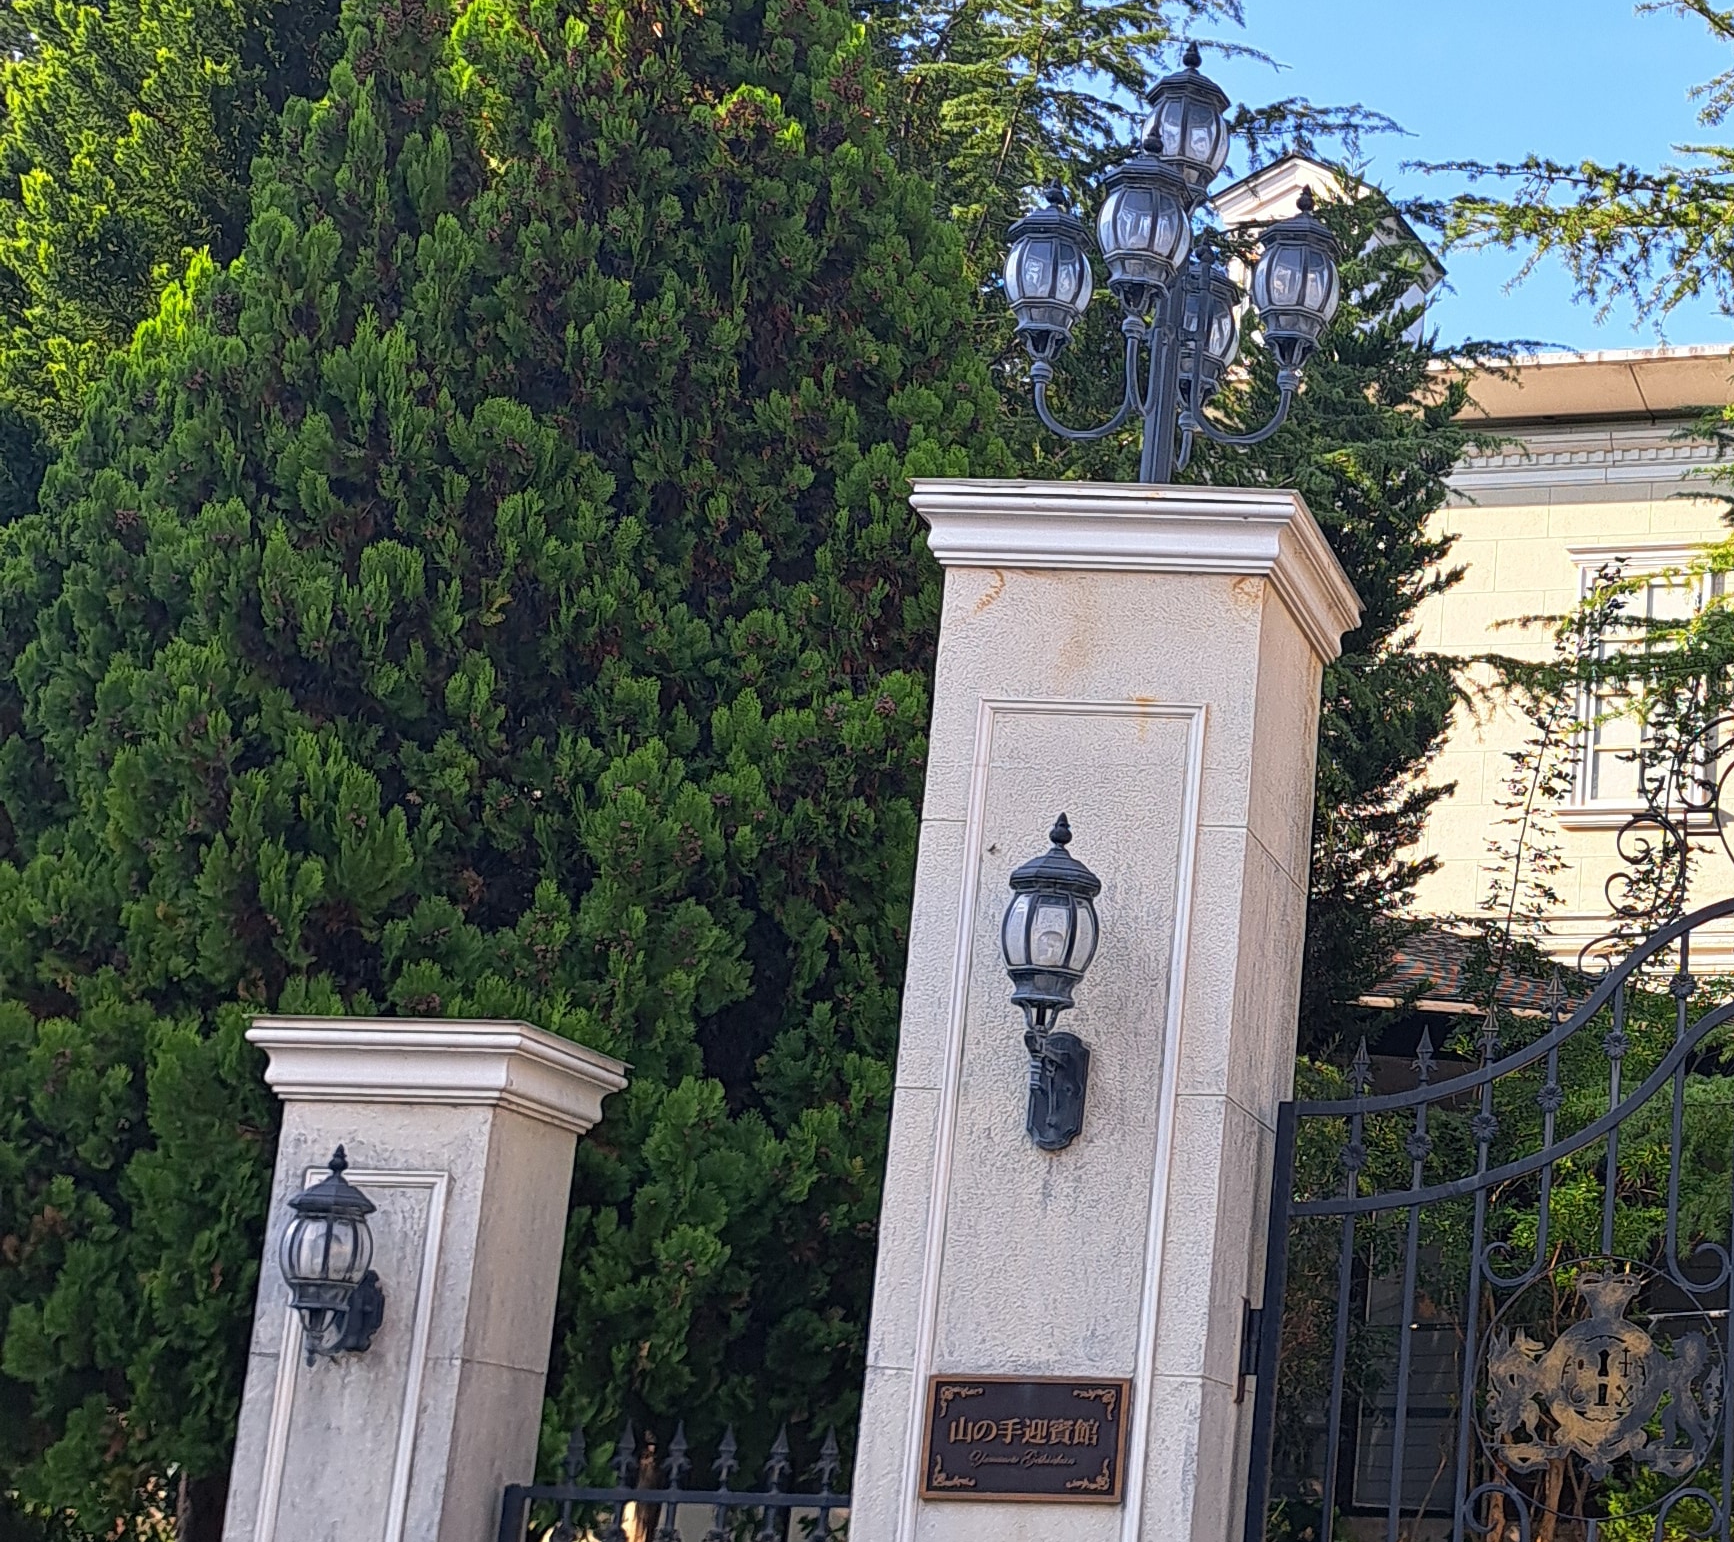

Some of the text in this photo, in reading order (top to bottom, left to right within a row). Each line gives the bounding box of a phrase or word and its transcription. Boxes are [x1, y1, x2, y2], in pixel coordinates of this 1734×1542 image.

[949, 1416, 1100, 1446] 山の手迎賓館
